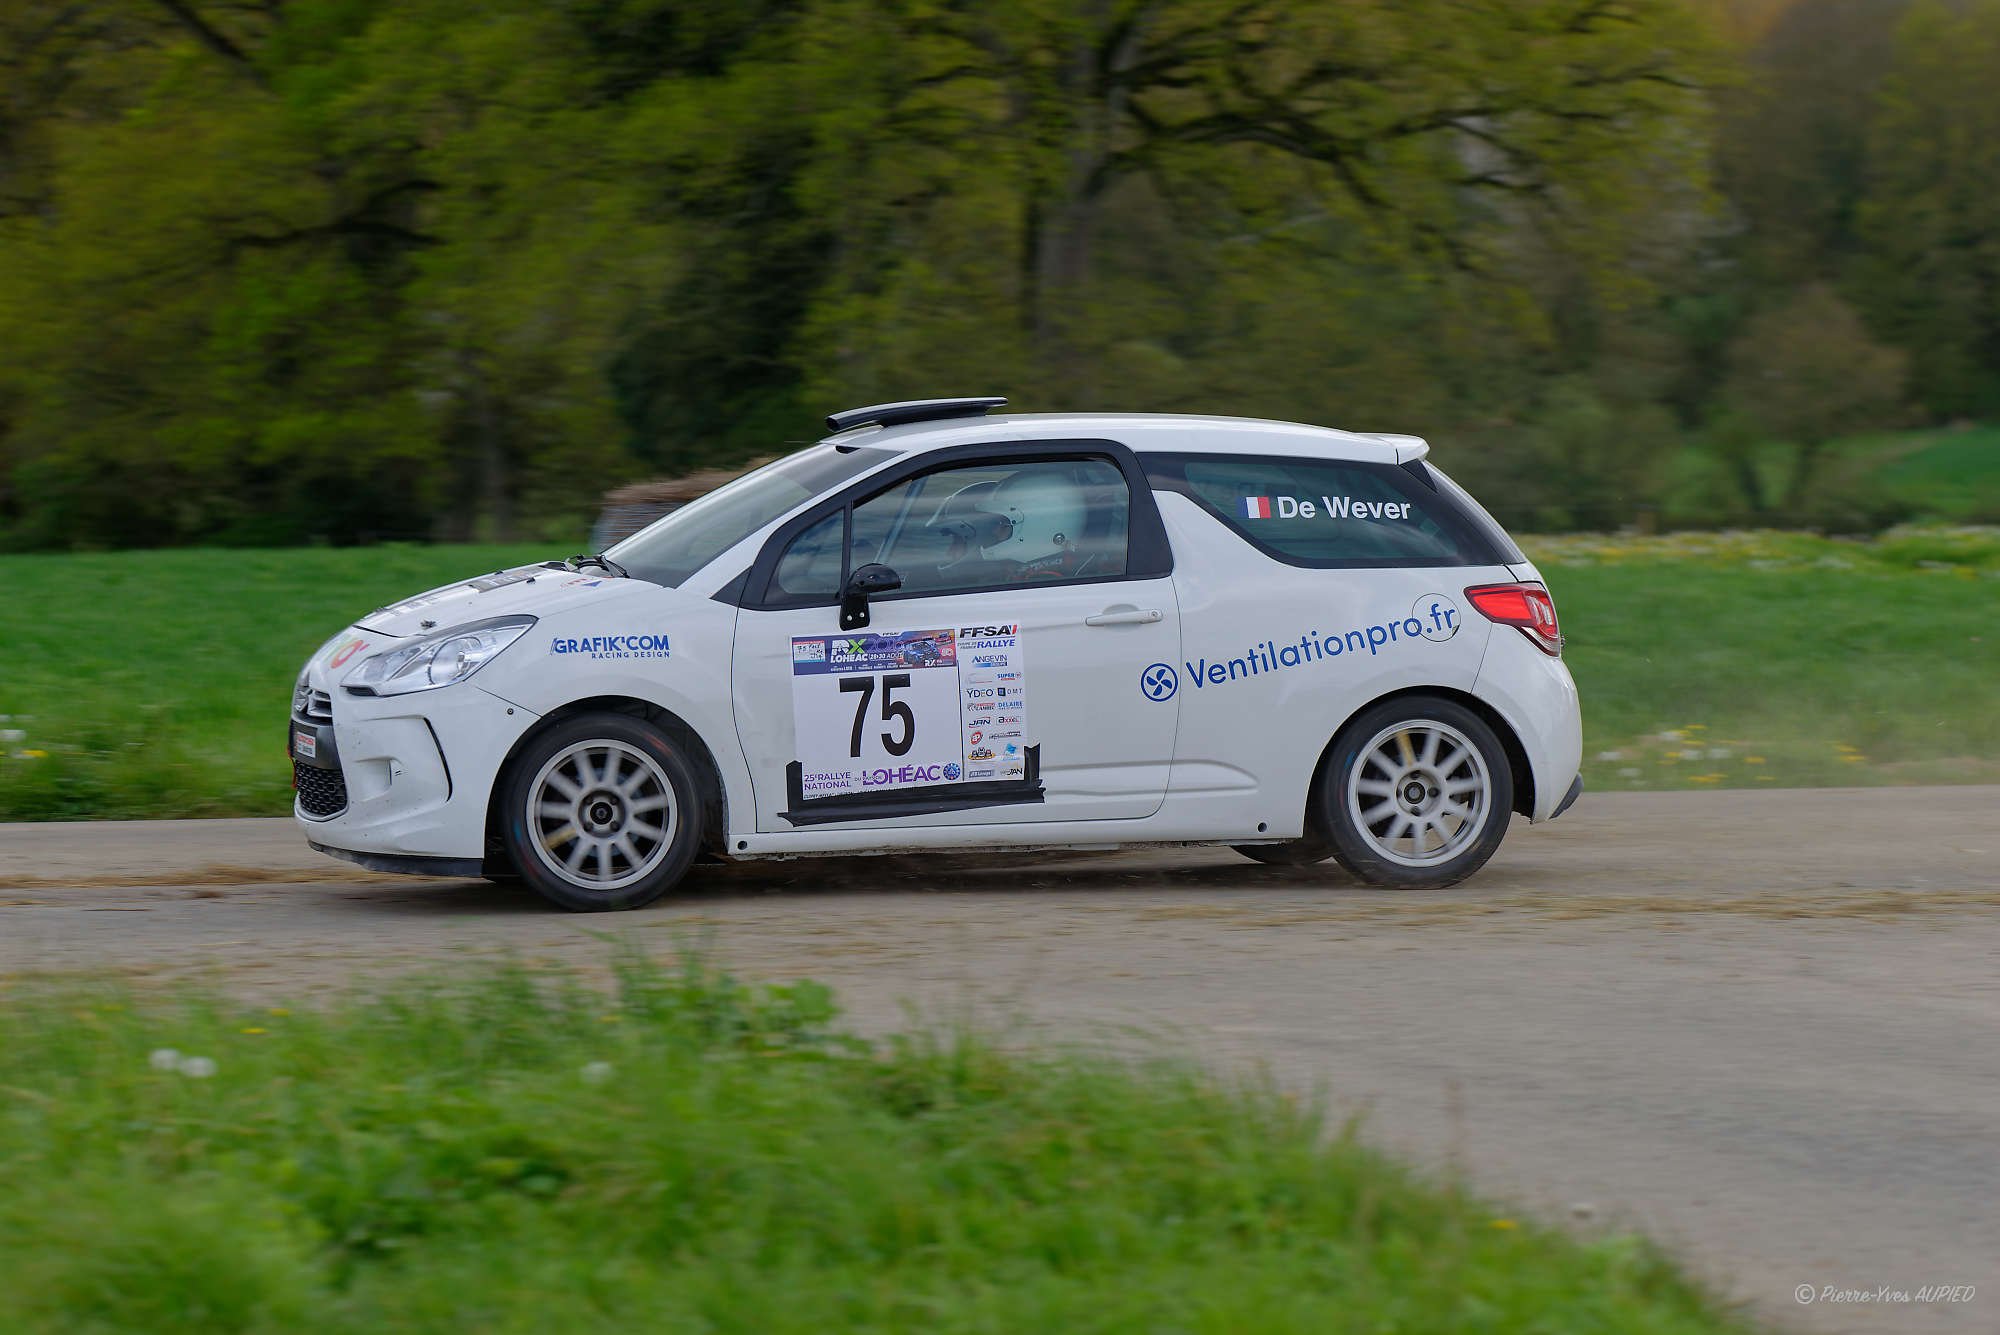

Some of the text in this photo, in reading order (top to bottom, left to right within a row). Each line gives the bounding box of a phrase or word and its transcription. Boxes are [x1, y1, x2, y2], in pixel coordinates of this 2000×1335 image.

[1277, 496, 1411, 519] De Wever
[960, 625, 1011, 638] FFSA
[976, 639, 1015, 649] RALLYE
[1186, 603, 1455, 688] Ventilationpro.fr
[591, 651, 630, 660] RACING
[830, 653, 869, 664] LOHEAC
[971, 654, 1008, 664] ANGEVIN
[839, 673, 915, 759] 75
[817, 771, 851, 781] RALLYE
[862, 764, 941, 786] LOHÉAC
[804, 780, 851, 791] NATIONAL
